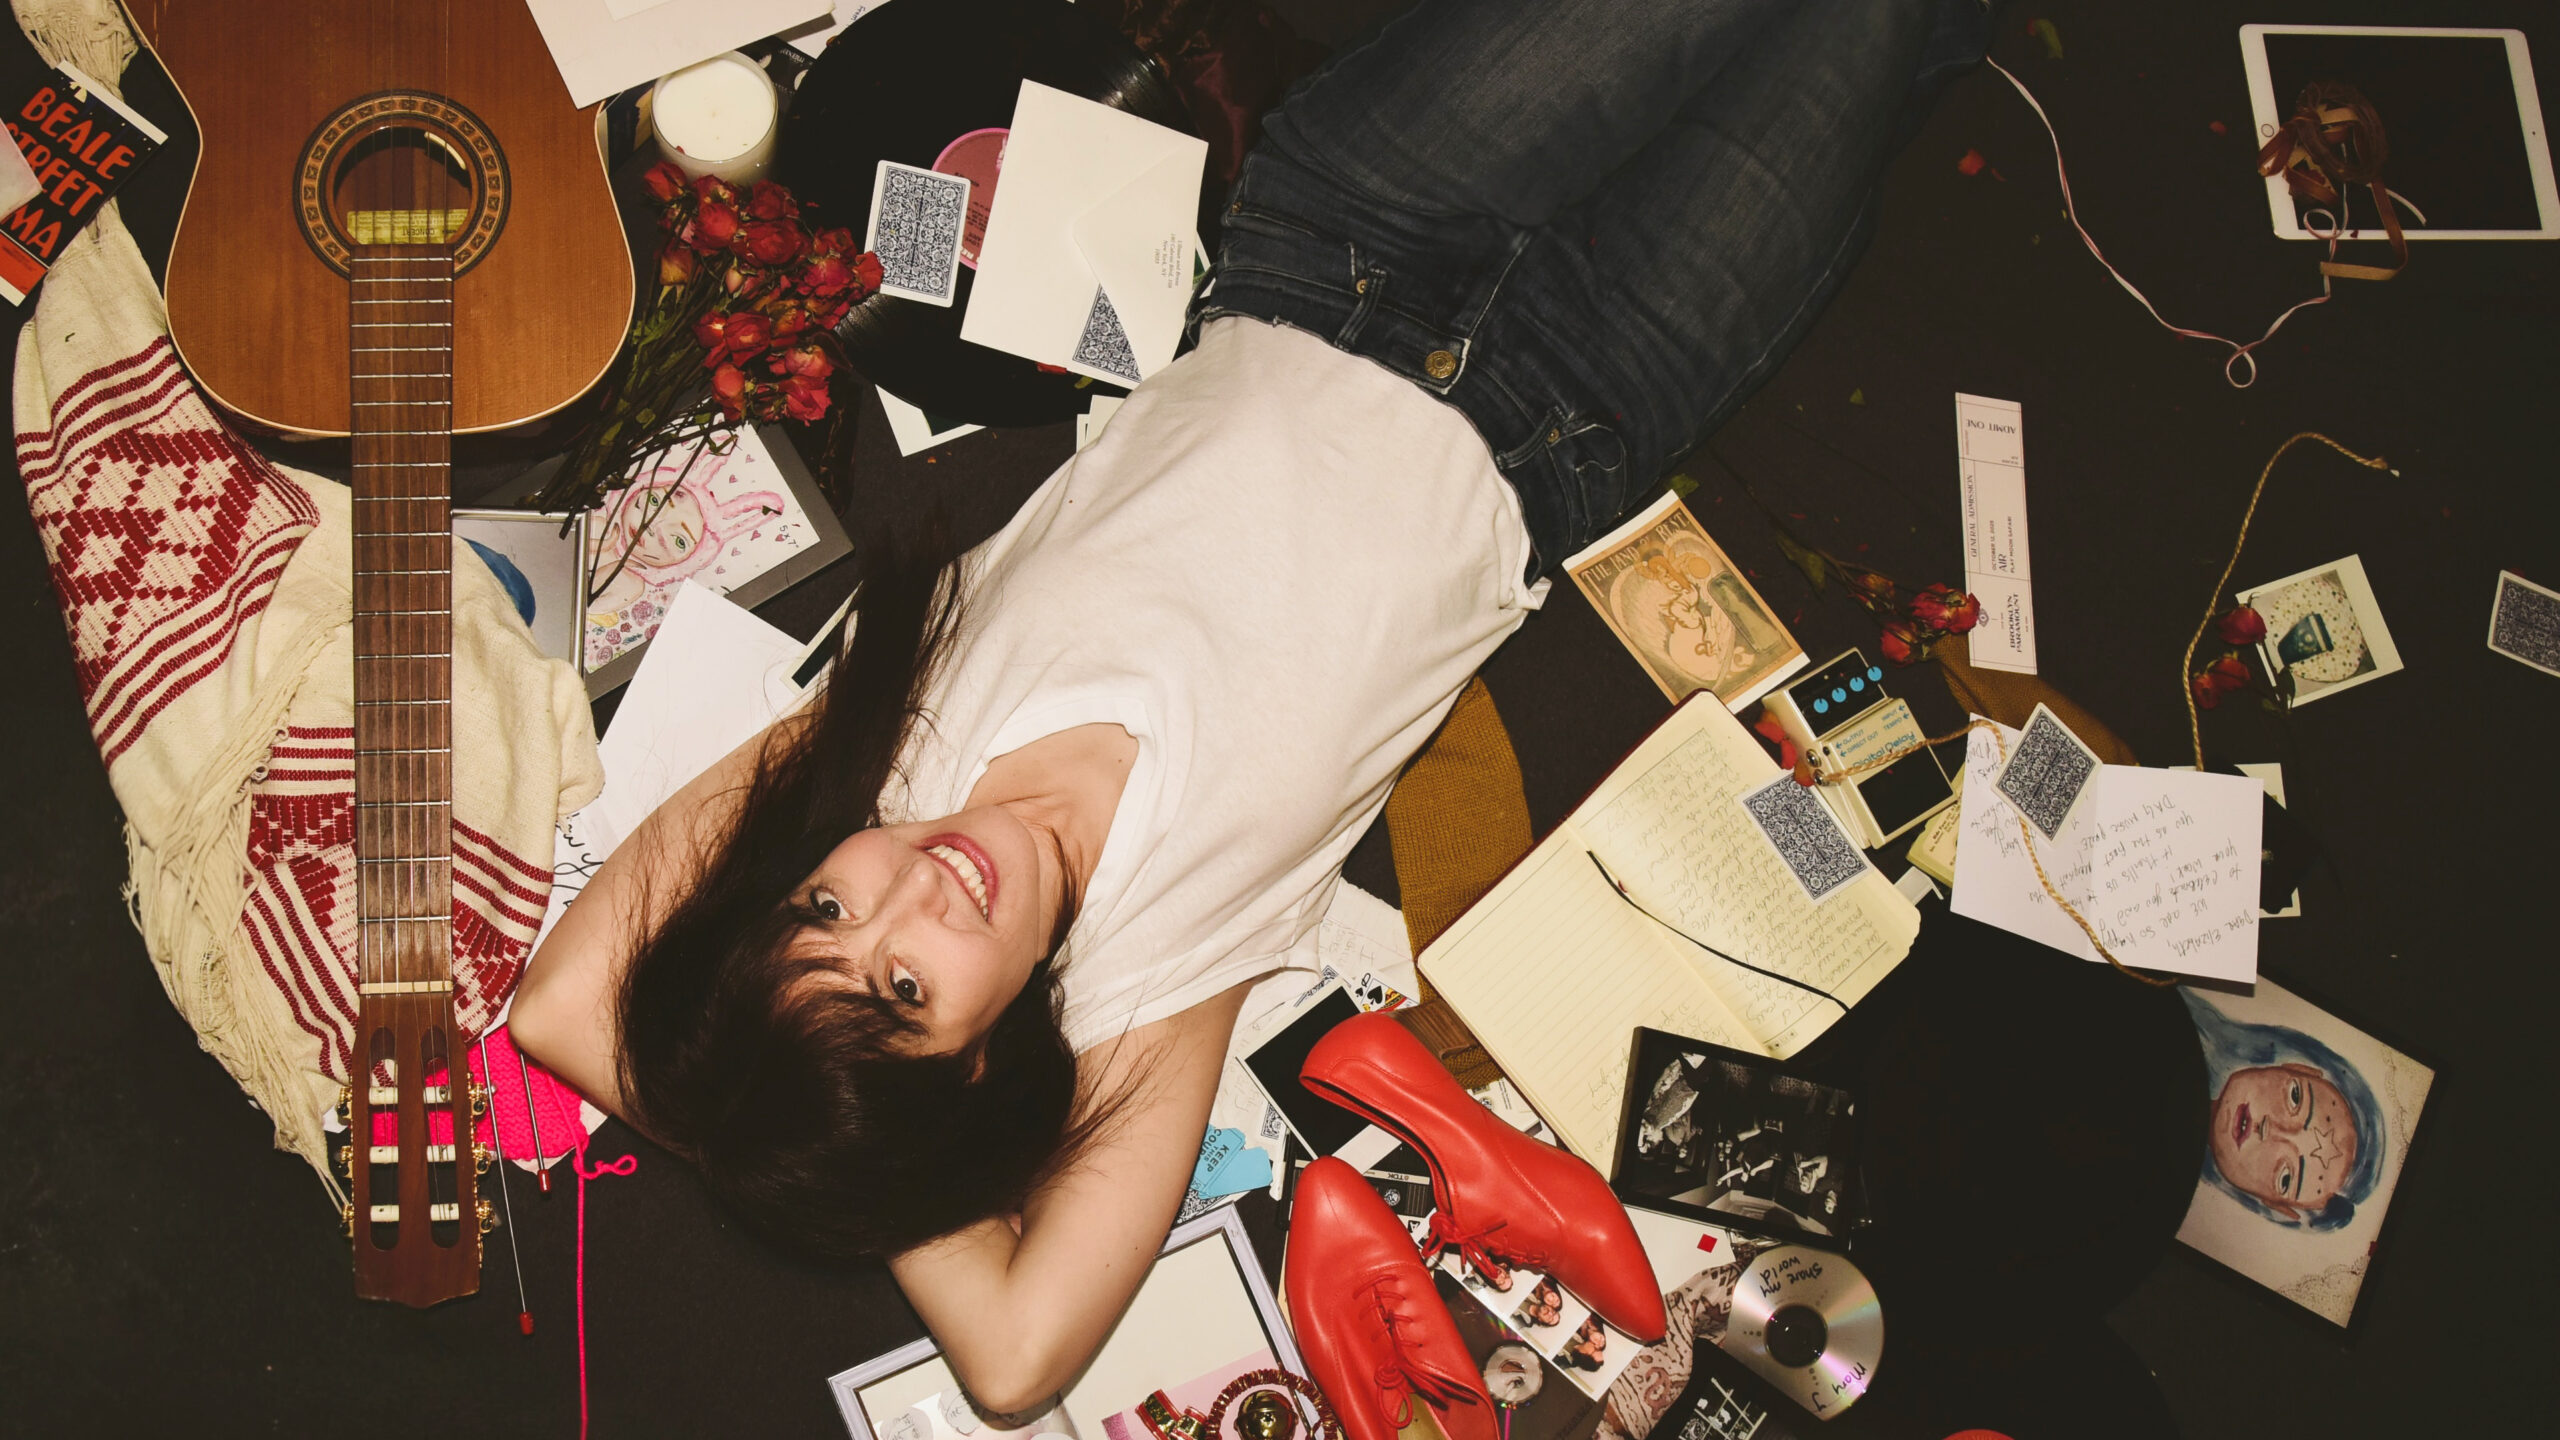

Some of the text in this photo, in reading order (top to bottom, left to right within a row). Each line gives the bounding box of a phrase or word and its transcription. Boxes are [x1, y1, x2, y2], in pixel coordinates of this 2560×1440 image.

[20, 86, 136, 180] BEALE
[8, 205, 62, 260] MA
[402, 226, 434, 237] CONCERT
[1967, 418, 2016, 434] ADMIT ONE
[1966, 474, 1978, 558] GENERAL ADMISSION
[1581, 560, 1611, 599] THE
[1610, 547, 1640, 571] LAND
[1998, 553, 2008, 572] AIR
[2007, 595, 2016, 649] BROOKLYN
[2012, 593, 2022, 653] PARAMOUNT
[1881, 708, 1897, 722] INPUT
[1883, 716, 1902, 730] TEMPO
[1842, 728, 1864, 746] OUTPUT
[1846, 730, 1879, 753] DIRECT OUT
[2145, 882, 2162, 908] you
[1360, 972, 1372, 988] Q
[1197, 1128, 1222, 1161] COUP
[1203, 1145, 1218, 1162] THIS
[1206, 1144, 1230, 1173] KEEP
[1388, 1172, 1404, 1181] TDK
[1759, 1255, 1805, 1286] world
[1760, 1280, 1782, 1298] my
